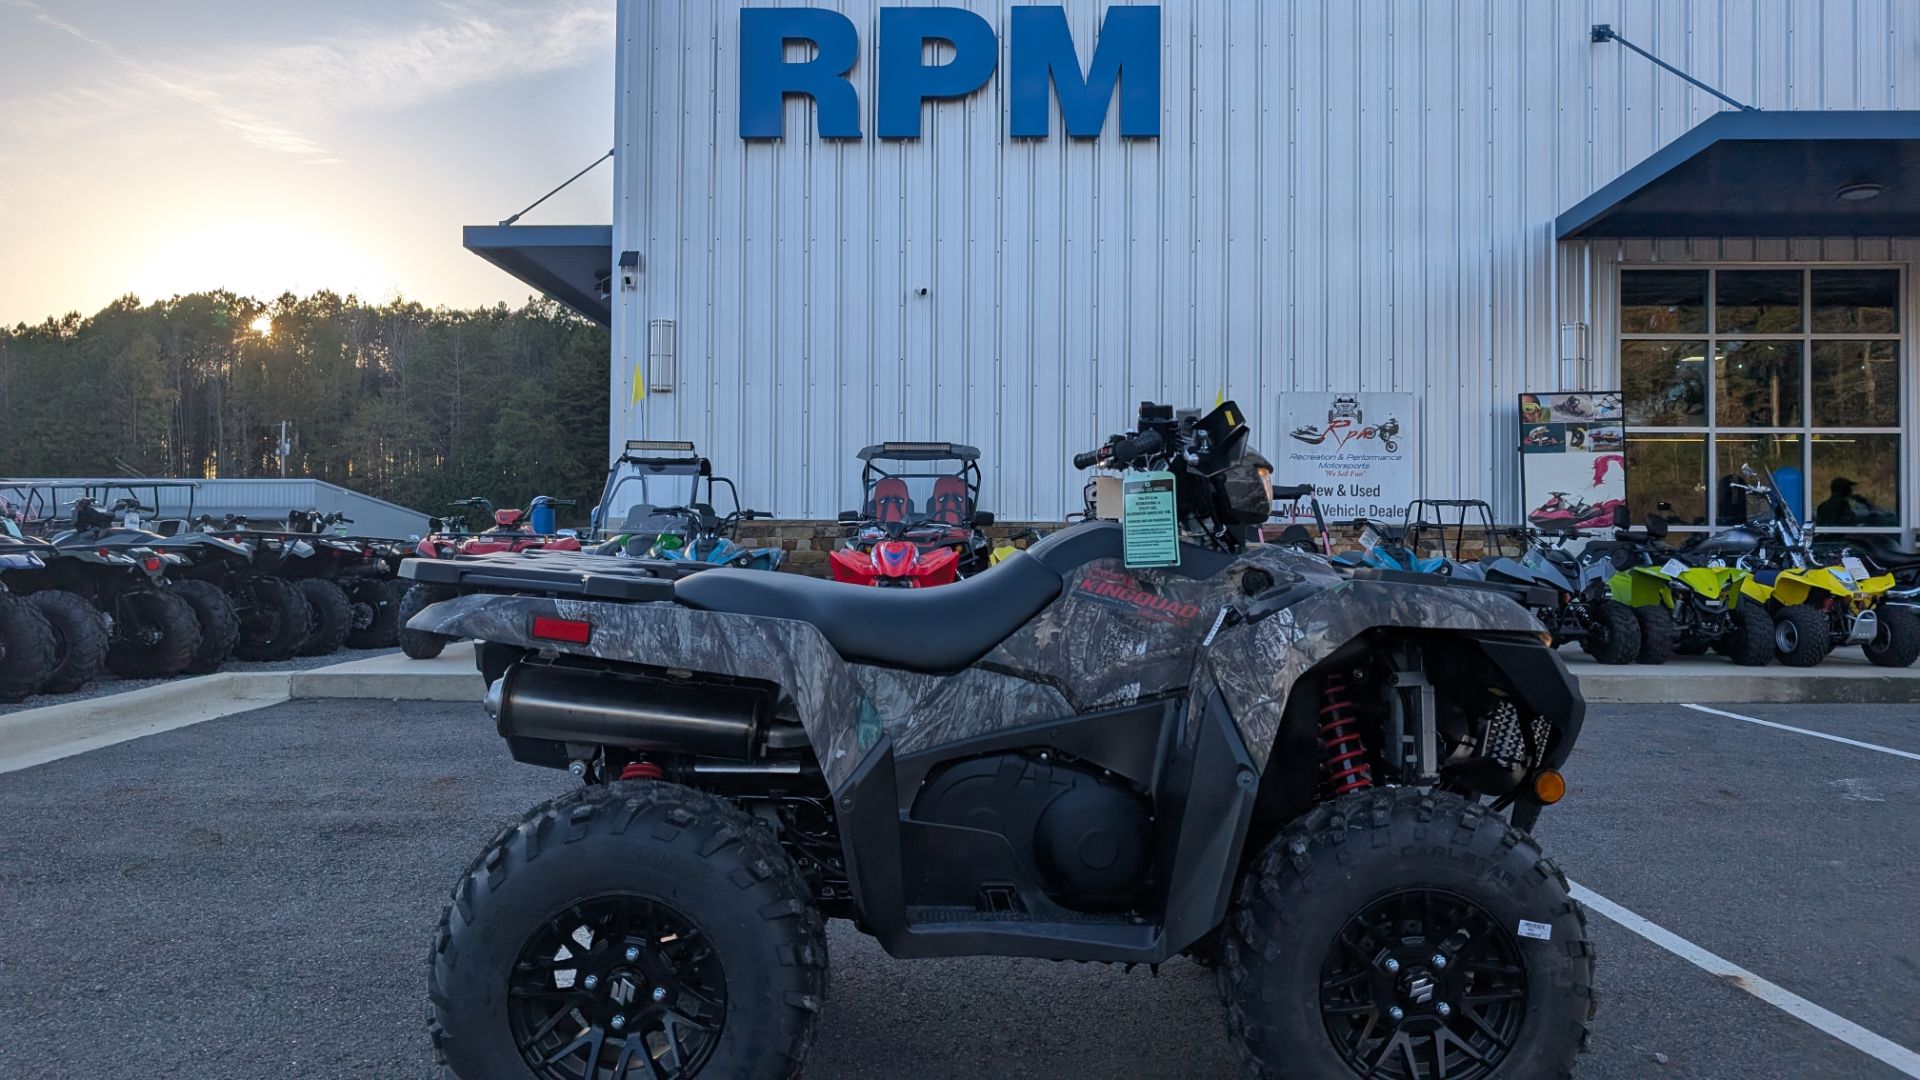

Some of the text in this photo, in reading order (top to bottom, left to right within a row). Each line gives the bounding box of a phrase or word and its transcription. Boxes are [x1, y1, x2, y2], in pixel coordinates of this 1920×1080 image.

[739, 5, 1161, 138] RPM
[1289, 453, 1402, 461] Recreation & Performance
[1318, 463, 1371, 471] Motorsports
[1337, 484, 1347, 497] &
[1350, 484, 1381, 497] Used
[1282, 503, 1410, 518] Moto Vehicle Dealer
[1079, 577, 1200, 618] KINGQUAD
